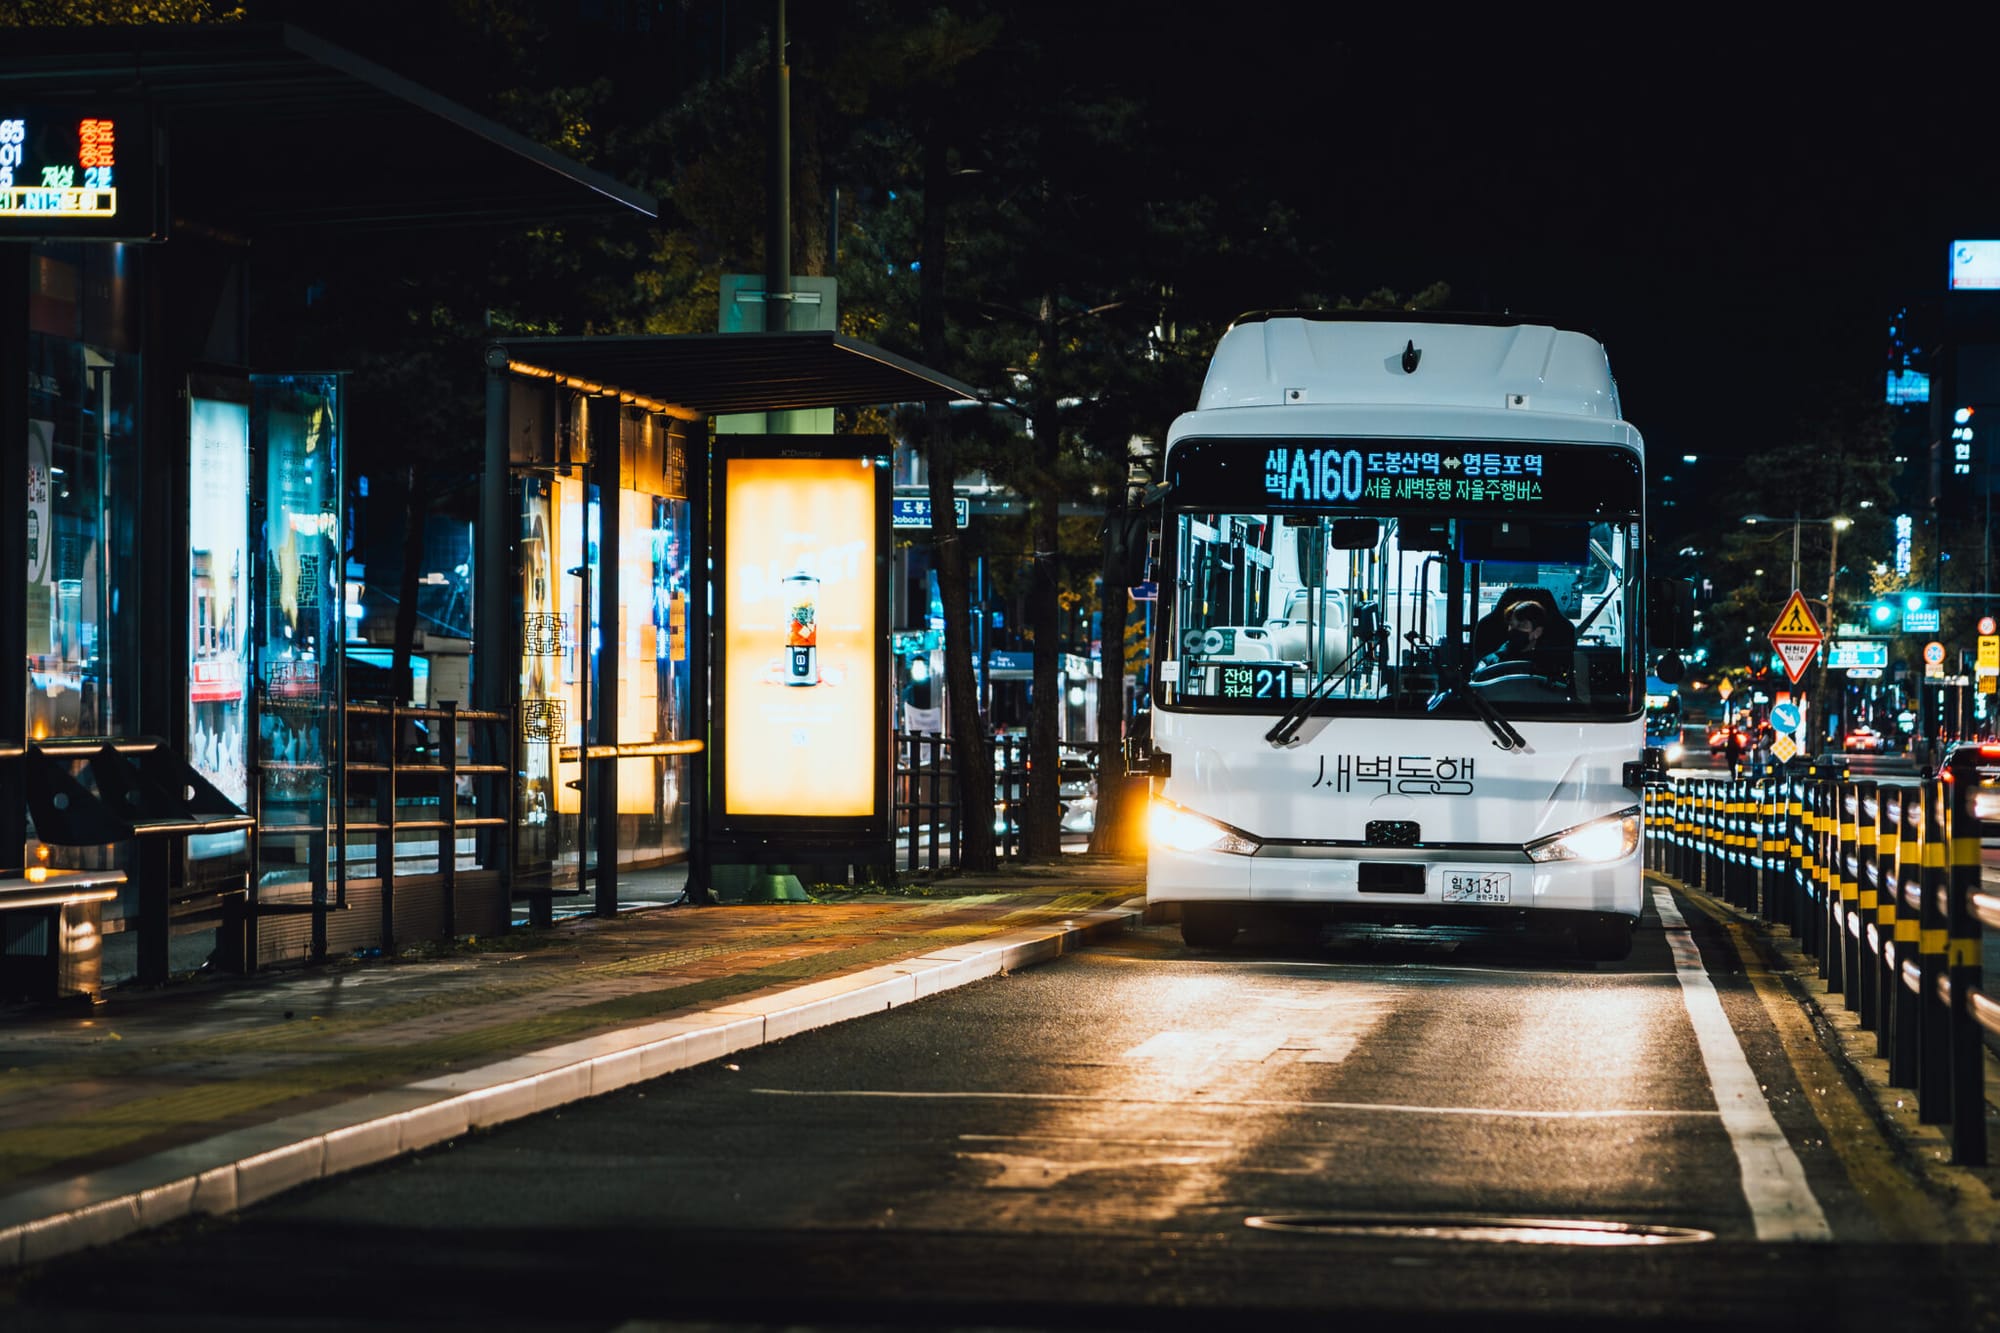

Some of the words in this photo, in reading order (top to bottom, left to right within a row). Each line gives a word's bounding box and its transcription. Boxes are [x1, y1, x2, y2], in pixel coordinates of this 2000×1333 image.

[1266, 448, 1288, 500] 새벽
[1288, 448, 1362, 500] A160
[1367, 452, 1440, 475] 도봉산역
[1463, 453, 1542, 476] 영등포역
[1365, 478, 1392, 499] 서울
[1395, 478, 1451, 500] 새벽동행
[1456, 480, 1543, 500] 자율주행버스
[1785, 645, 1808, 654] 천천히
[1224, 668, 1253, 684] 잔여
[1256, 670, 1286, 699] 21
[1224, 686, 1253, 698] 좌석
[1312, 754, 1475, 796] 새벽동행
[1451, 876, 1463, 890] 임
[1465, 877, 1499, 894] 3131
